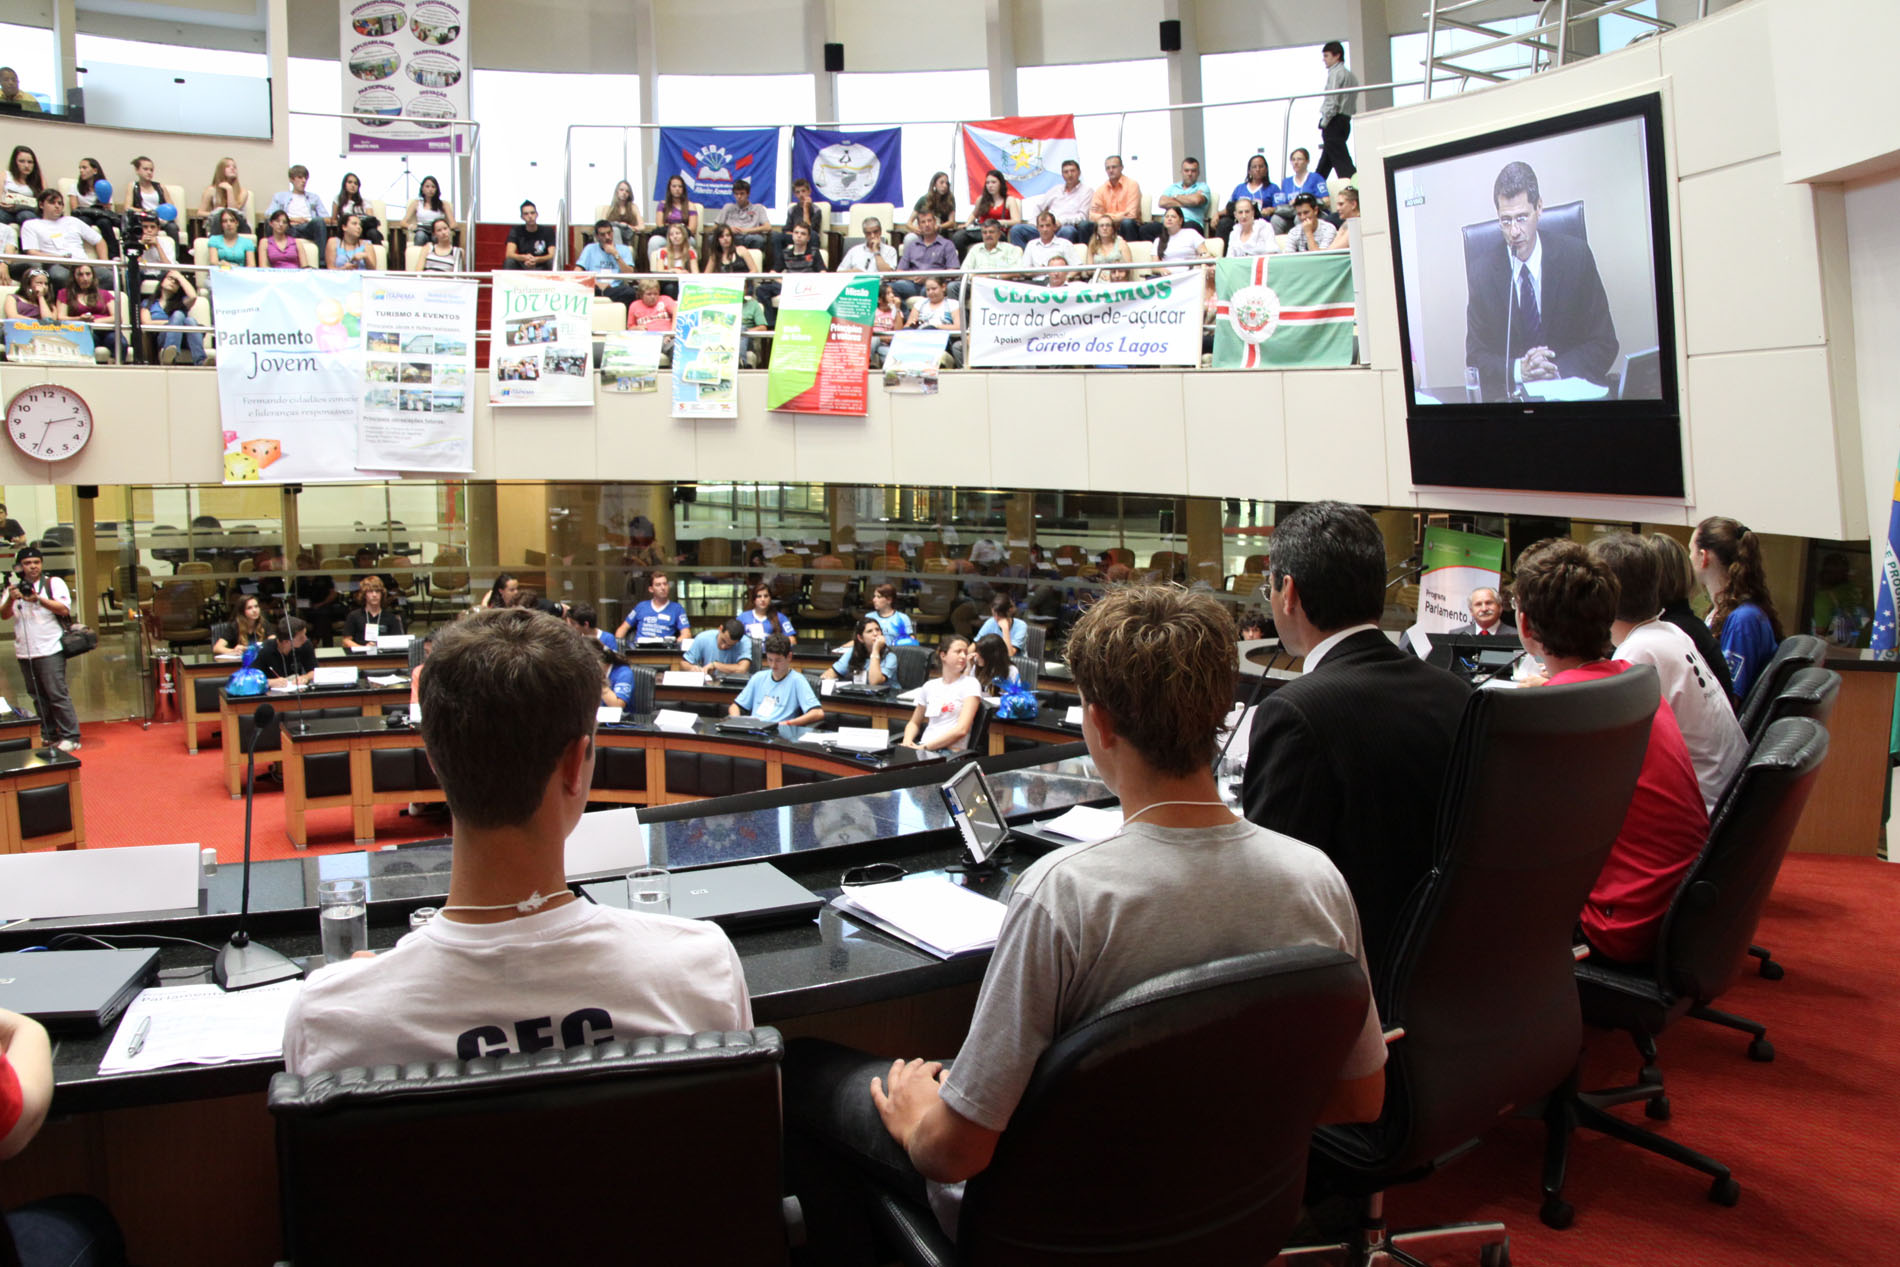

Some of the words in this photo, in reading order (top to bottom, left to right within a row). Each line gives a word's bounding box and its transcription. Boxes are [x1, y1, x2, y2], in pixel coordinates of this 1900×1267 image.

[503, 289, 588, 318] Jovem
[376, 310, 412, 318] TURISMO
[423, 312, 461, 320] EVENTOS
[981, 307, 1020, 327] Terra
[1024, 307, 1044, 327] da
[1050, 305, 1186, 329] Cana-de-açúcar
[217, 329, 313, 347] Parlamento
[993, 336, 1022, 345] Apoio:
[1026, 337, 1080, 353] Correio
[1085, 337, 1113, 353] dos
[1118, 336, 1168, 356] Lagos
[247, 352, 318, 379] Jovem
[18, 404, 31, 412] 10
[72, 406, 79, 414] 2
[1425, 601, 1468, 623] Parlamento
